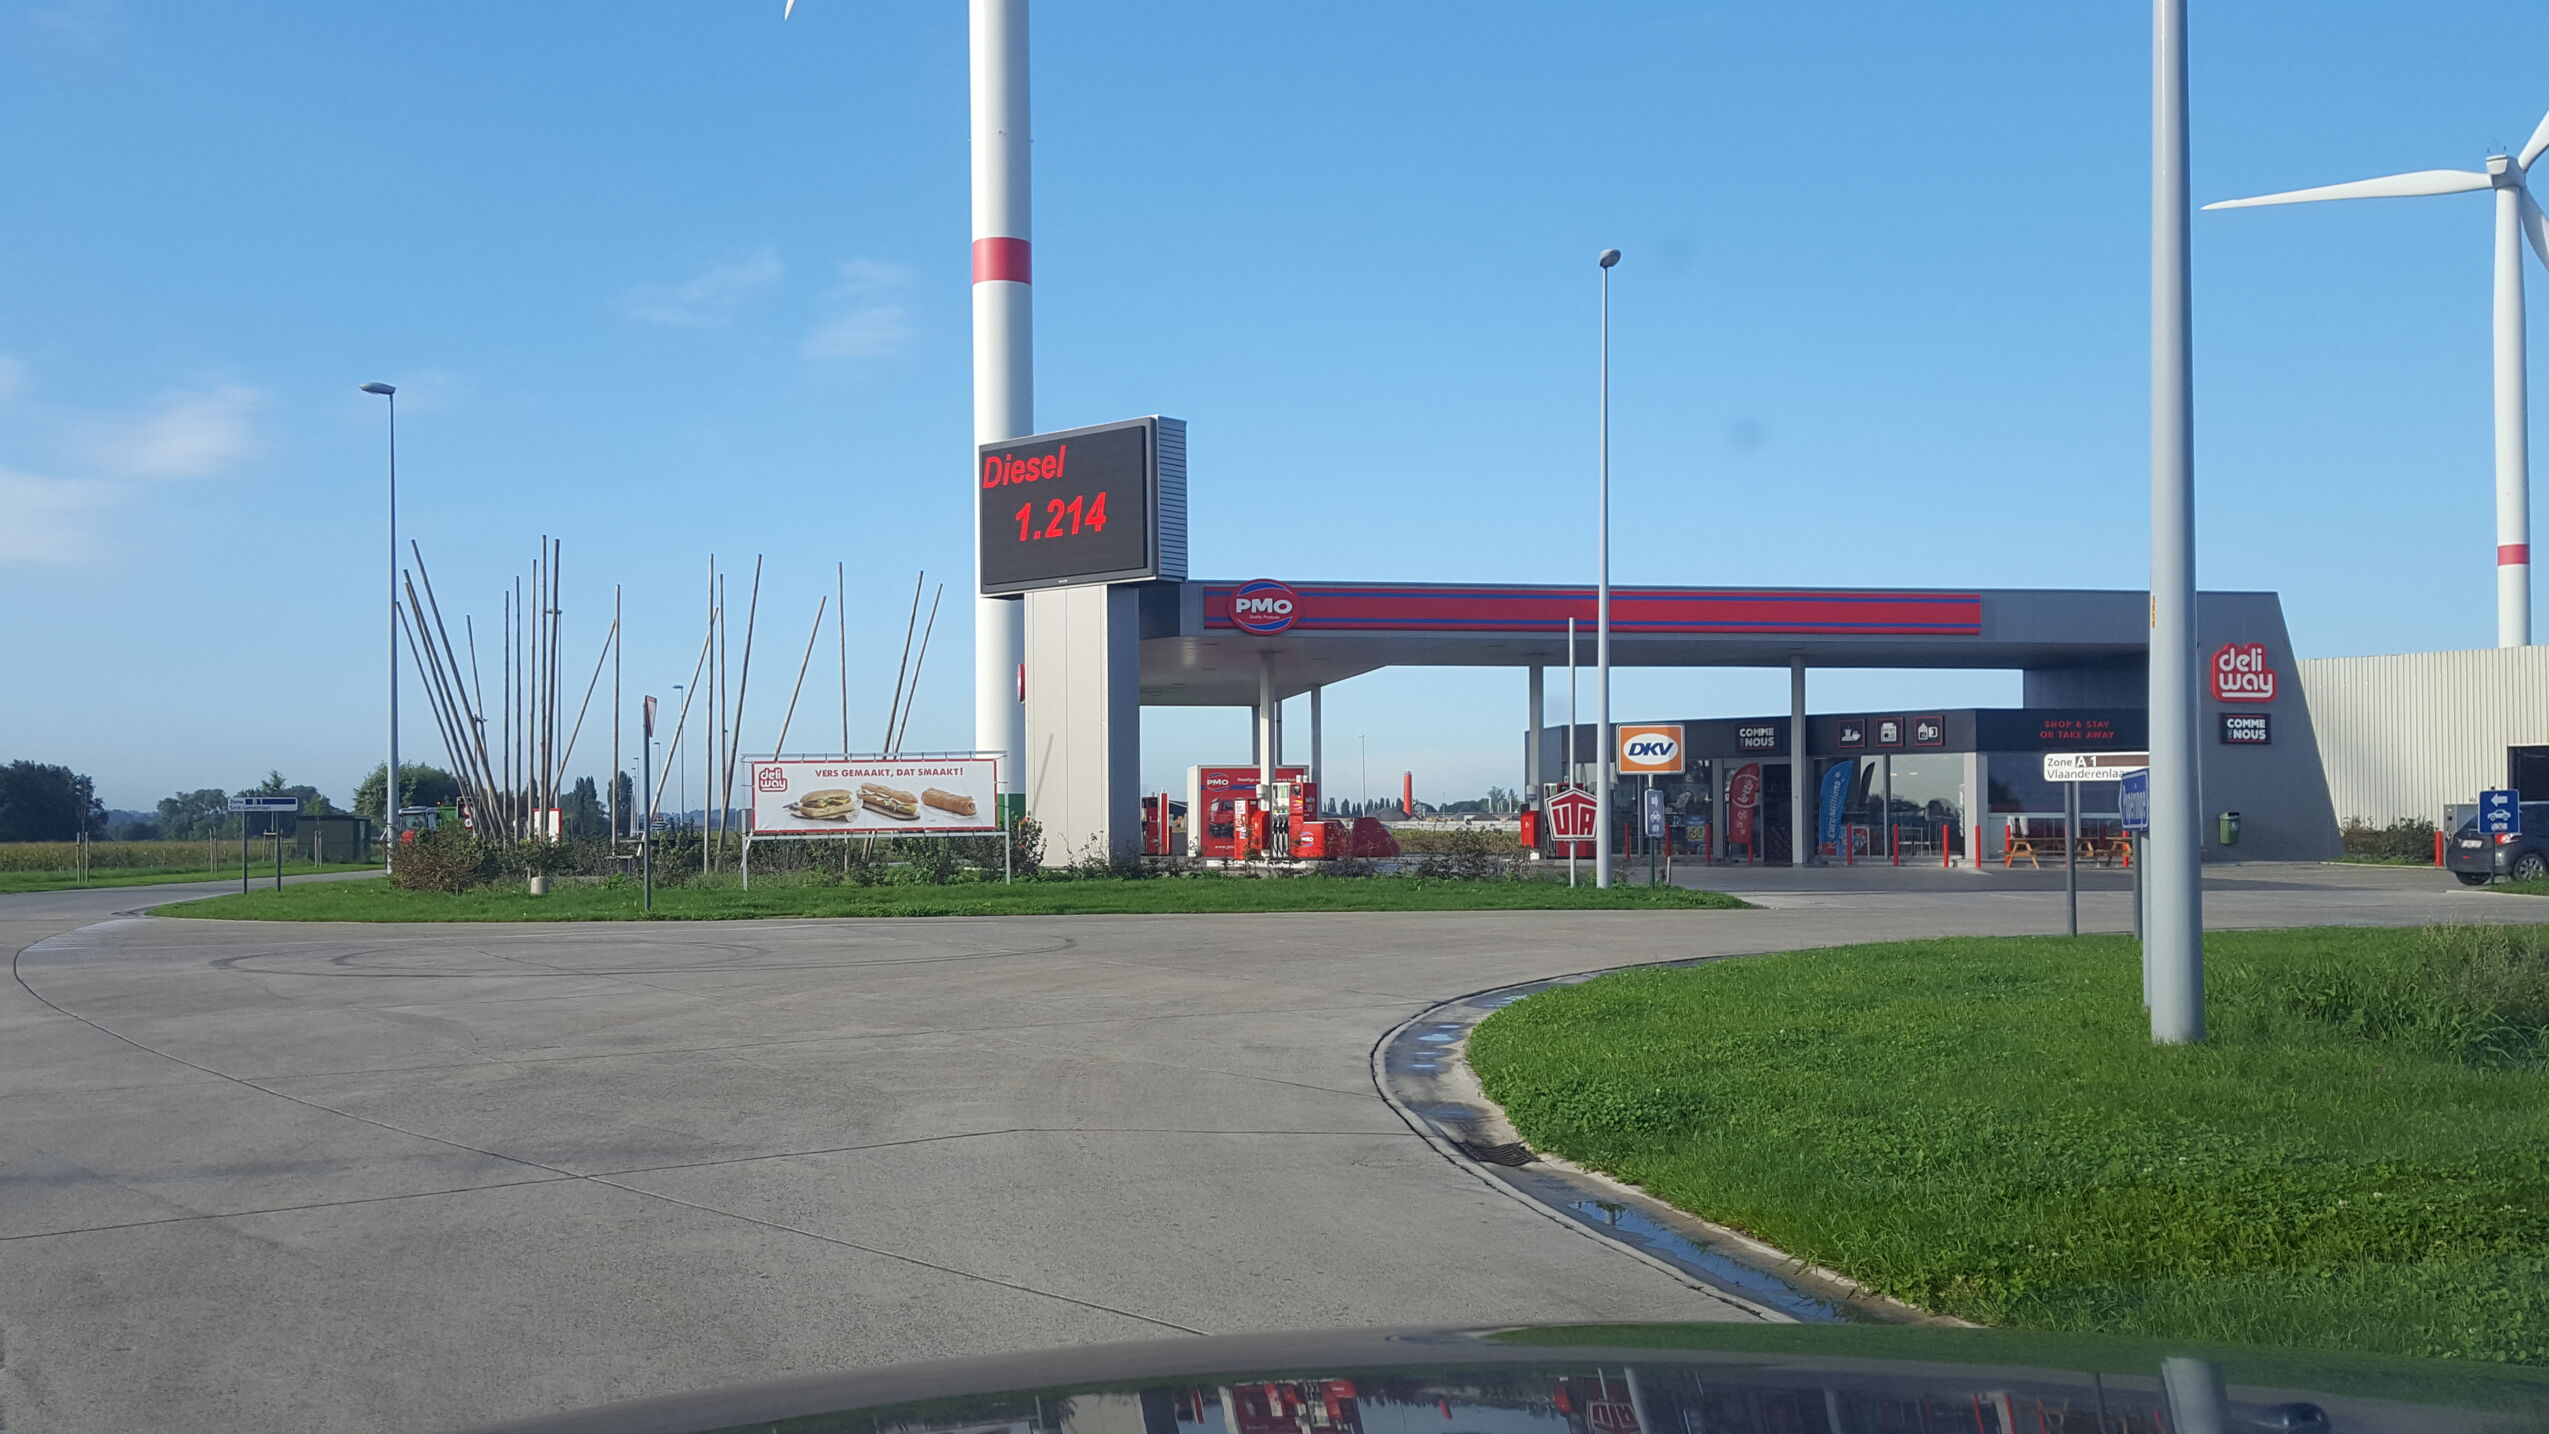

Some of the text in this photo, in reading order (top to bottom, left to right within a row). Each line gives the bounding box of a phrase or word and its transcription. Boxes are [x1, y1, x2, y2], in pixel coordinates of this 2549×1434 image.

[983, 445, 1067, 489] Diesel
[1015, 491, 1107, 542] 1.214
[1236, 598, 1293, 614] PMO
[2219, 648, 2262, 671] deli
[2219, 673, 2273, 697] way
[2044, 720, 2072, 728] SHOP
[2086, 720, 2110, 728] STAY
[2227, 719, 2266, 728] COMME
[1740, 728, 1775, 737] COMME
[2040, 731, 2115, 739] OR TAKE AWAY
[2233, 729, 2266, 740] NOUS
[1745, 737, 1775, 747] NOUS
[1628, 742, 1674, 756] DKV
[2047, 756, 2097, 767] Zone A 1
[760, 769, 782, 779] deli
[842, 769, 894, 777] GEMAAKT,
[896, 768, 915, 776] DAT
[918, 768, 964, 776] SMAAKT!
[2047, 769, 2127, 779] Vlaanderenlaa
[760, 780, 786, 790] way
[1552, 793, 1597, 835] UTA
